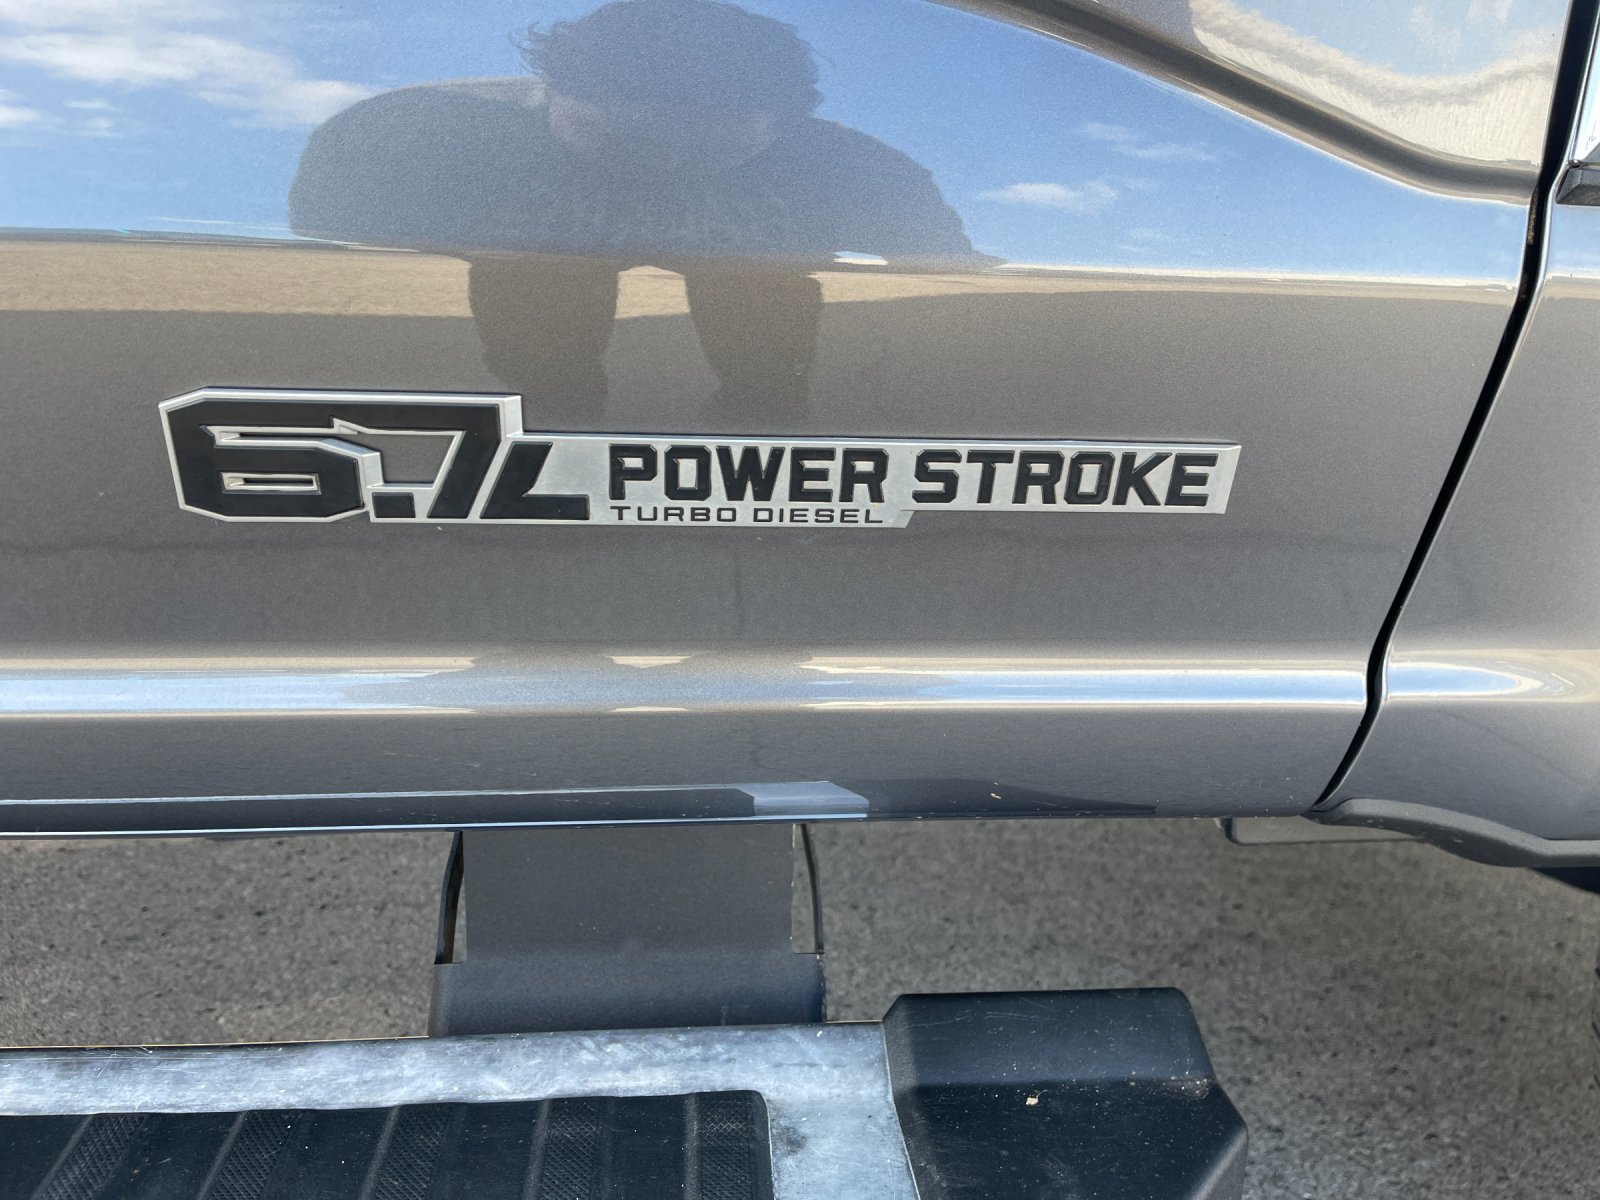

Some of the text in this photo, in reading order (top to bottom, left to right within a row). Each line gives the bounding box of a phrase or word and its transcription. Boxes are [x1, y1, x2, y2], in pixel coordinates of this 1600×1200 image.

[608, 443, 889, 503] POWER
[911, 448, 1219, 507] STROKE
[609, 505, 884, 524] TURBO DIESEL
